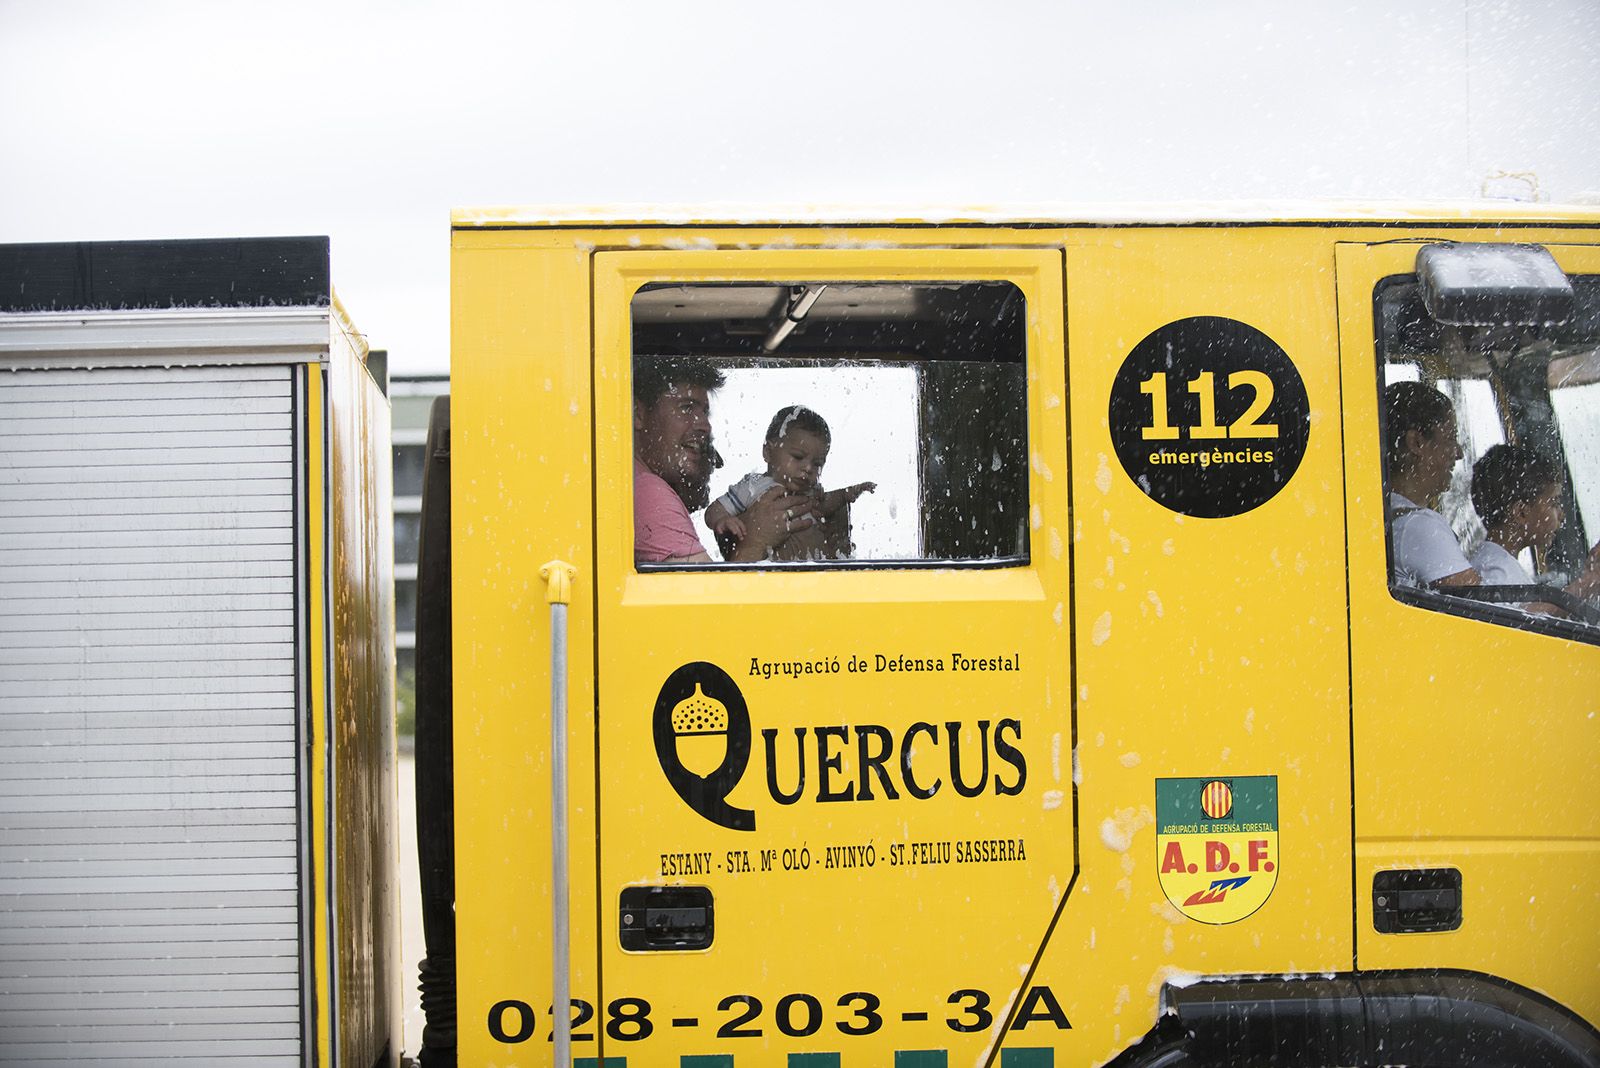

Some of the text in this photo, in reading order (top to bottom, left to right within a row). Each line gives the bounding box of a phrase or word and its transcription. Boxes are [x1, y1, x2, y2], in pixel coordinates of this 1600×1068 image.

[1140, 369, 1279, 440] 112
[1149, 447, 1274, 467] emergències
[749, 653, 1020, 680] Agrupació de Defensa Forestal
[652, 661, 1028, 832] QUERCUS
[1163, 822, 1274, 834] AGRUPACIÓ DE DEFENSA FORESTAL
[660, 852, 712, 876] ESTANY
[726, 850, 756, 874] STA.
[782, 841, 811, 871] OLÓ
[825, 839, 876, 869] AVINYÓ
[956, 839, 1027, 864] SASSERRA
